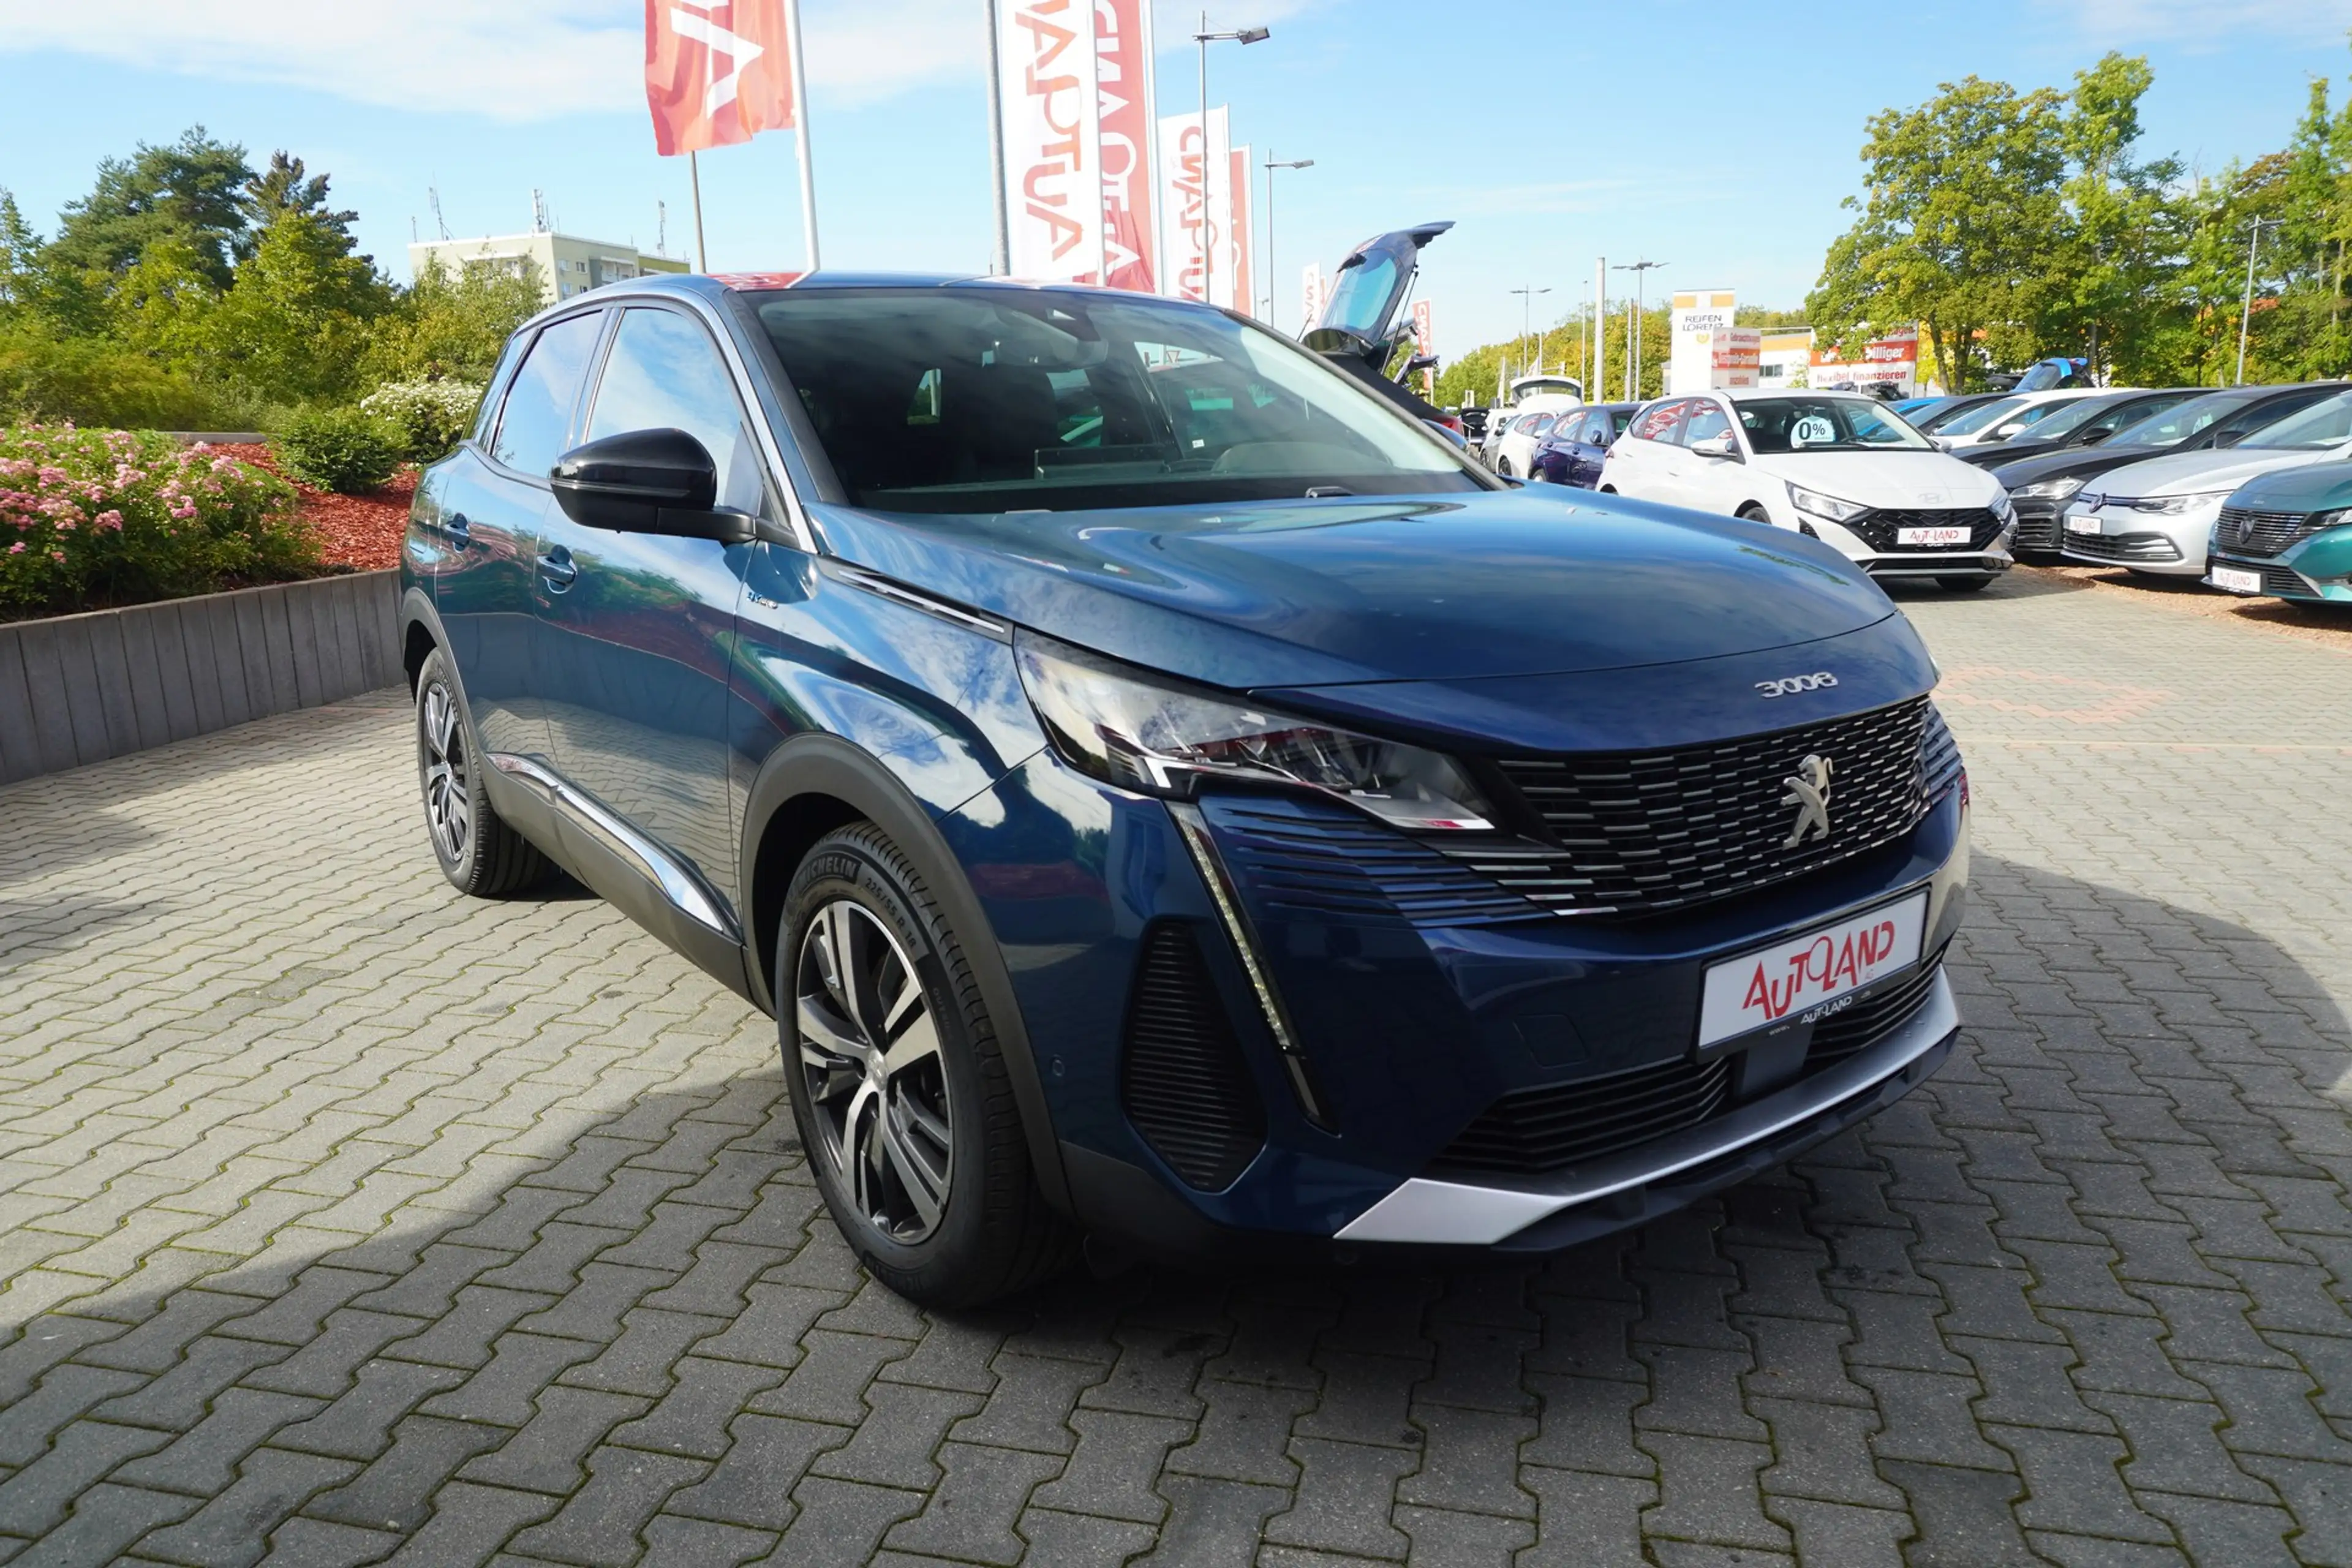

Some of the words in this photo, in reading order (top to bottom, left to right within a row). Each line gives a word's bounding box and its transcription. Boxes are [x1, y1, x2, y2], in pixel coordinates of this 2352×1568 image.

[1853, 370, 1907, 380] finanzieren
[1754, 671, 1839, 698] 3008
[865, 878, 898, 916] 225/55
[1741, 921, 1895, 1020] AUTOLAND
[1800, 996, 1853, 1025] AUTOLAND
